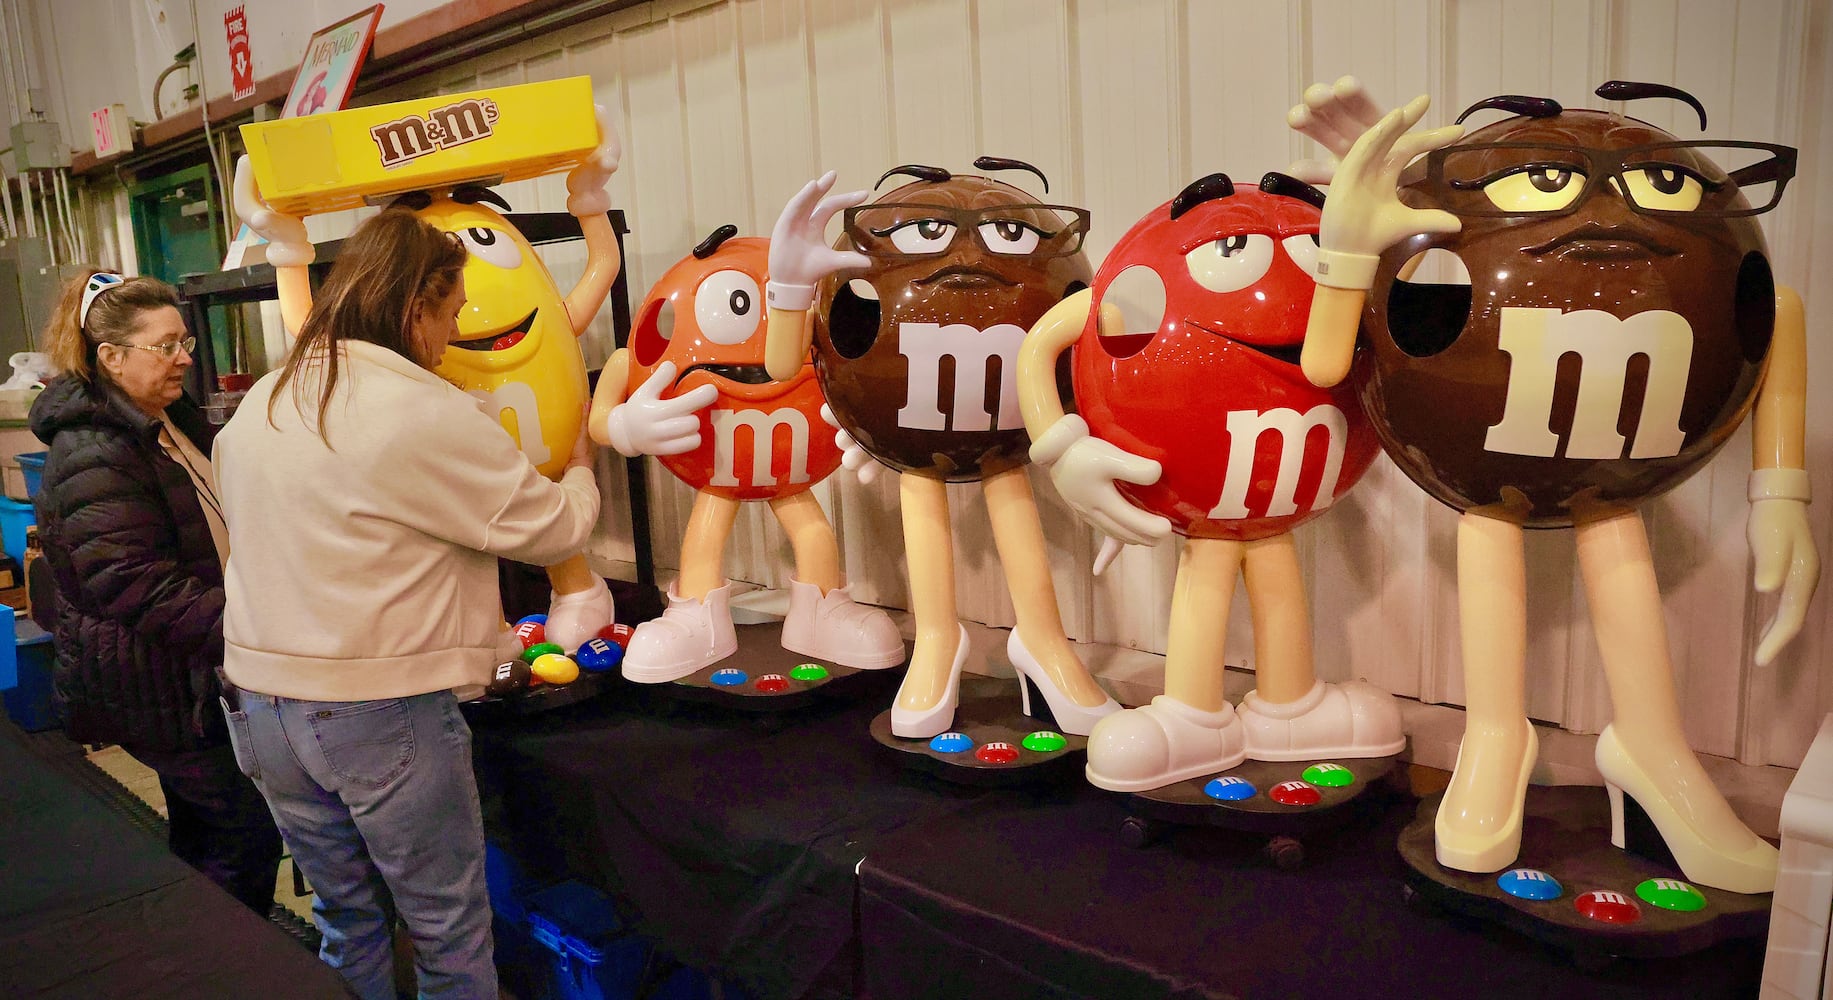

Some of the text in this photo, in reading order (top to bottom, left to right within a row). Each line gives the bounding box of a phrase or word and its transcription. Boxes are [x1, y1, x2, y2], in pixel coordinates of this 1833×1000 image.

[228, 18, 244, 36] FIRE
[897, 322, 1029, 432] m
[1483, 306, 1694, 460] m
[709, 407, 811, 487] m
[1206, 403, 1348, 519] m
[1515, 870, 1546, 882] m
[1592, 891, 1626, 905] m
[1654, 879, 1689, 892] m
